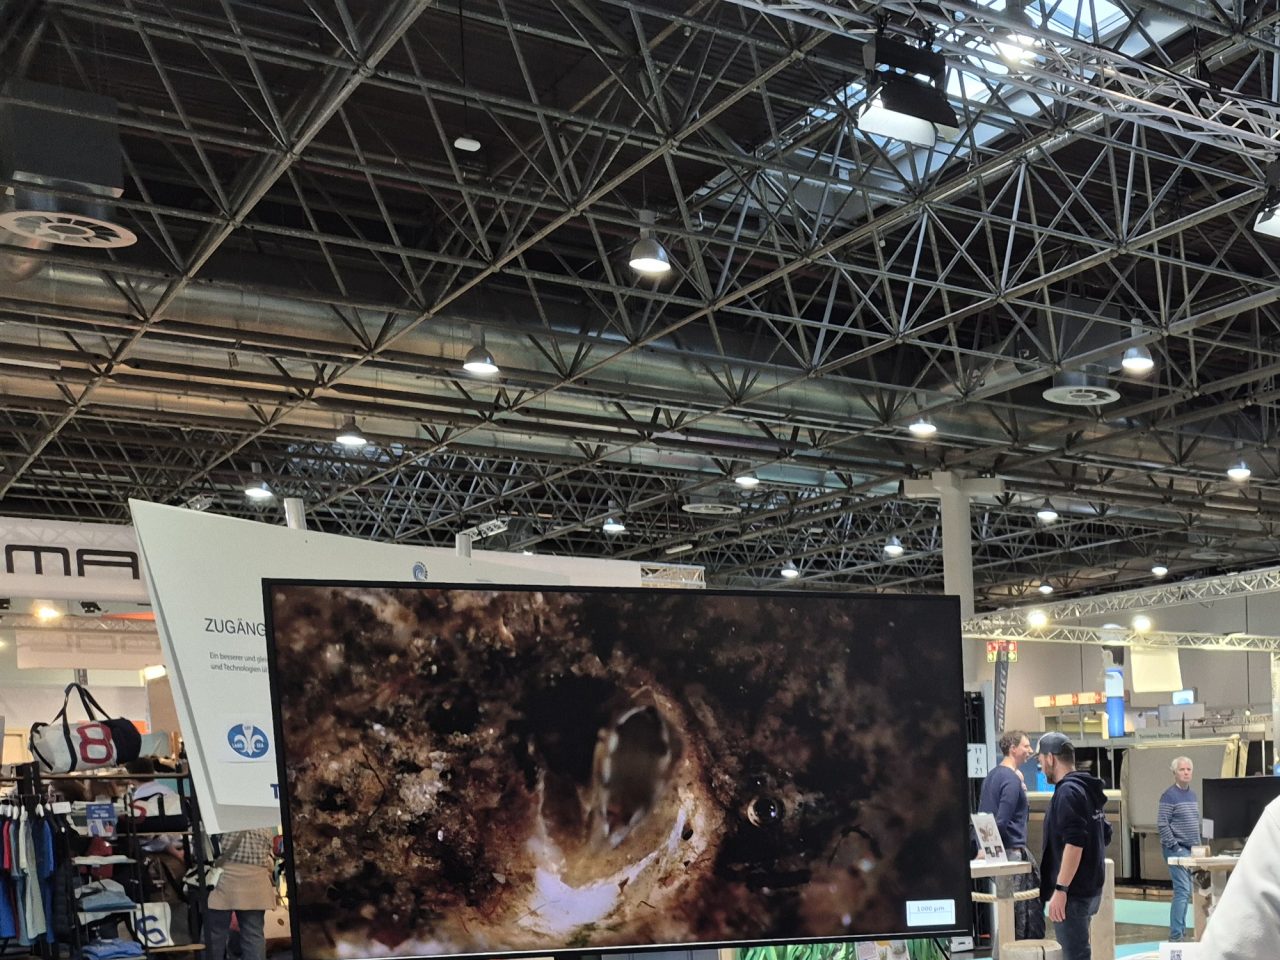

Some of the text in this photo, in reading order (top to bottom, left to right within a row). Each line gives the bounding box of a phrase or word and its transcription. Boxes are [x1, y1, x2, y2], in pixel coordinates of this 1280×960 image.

[219, 652, 243, 662] besserer
[244, 654, 255, 662] und
[224, 664, 260, 673] Technologien
[76, 723, 114, 764] 8
